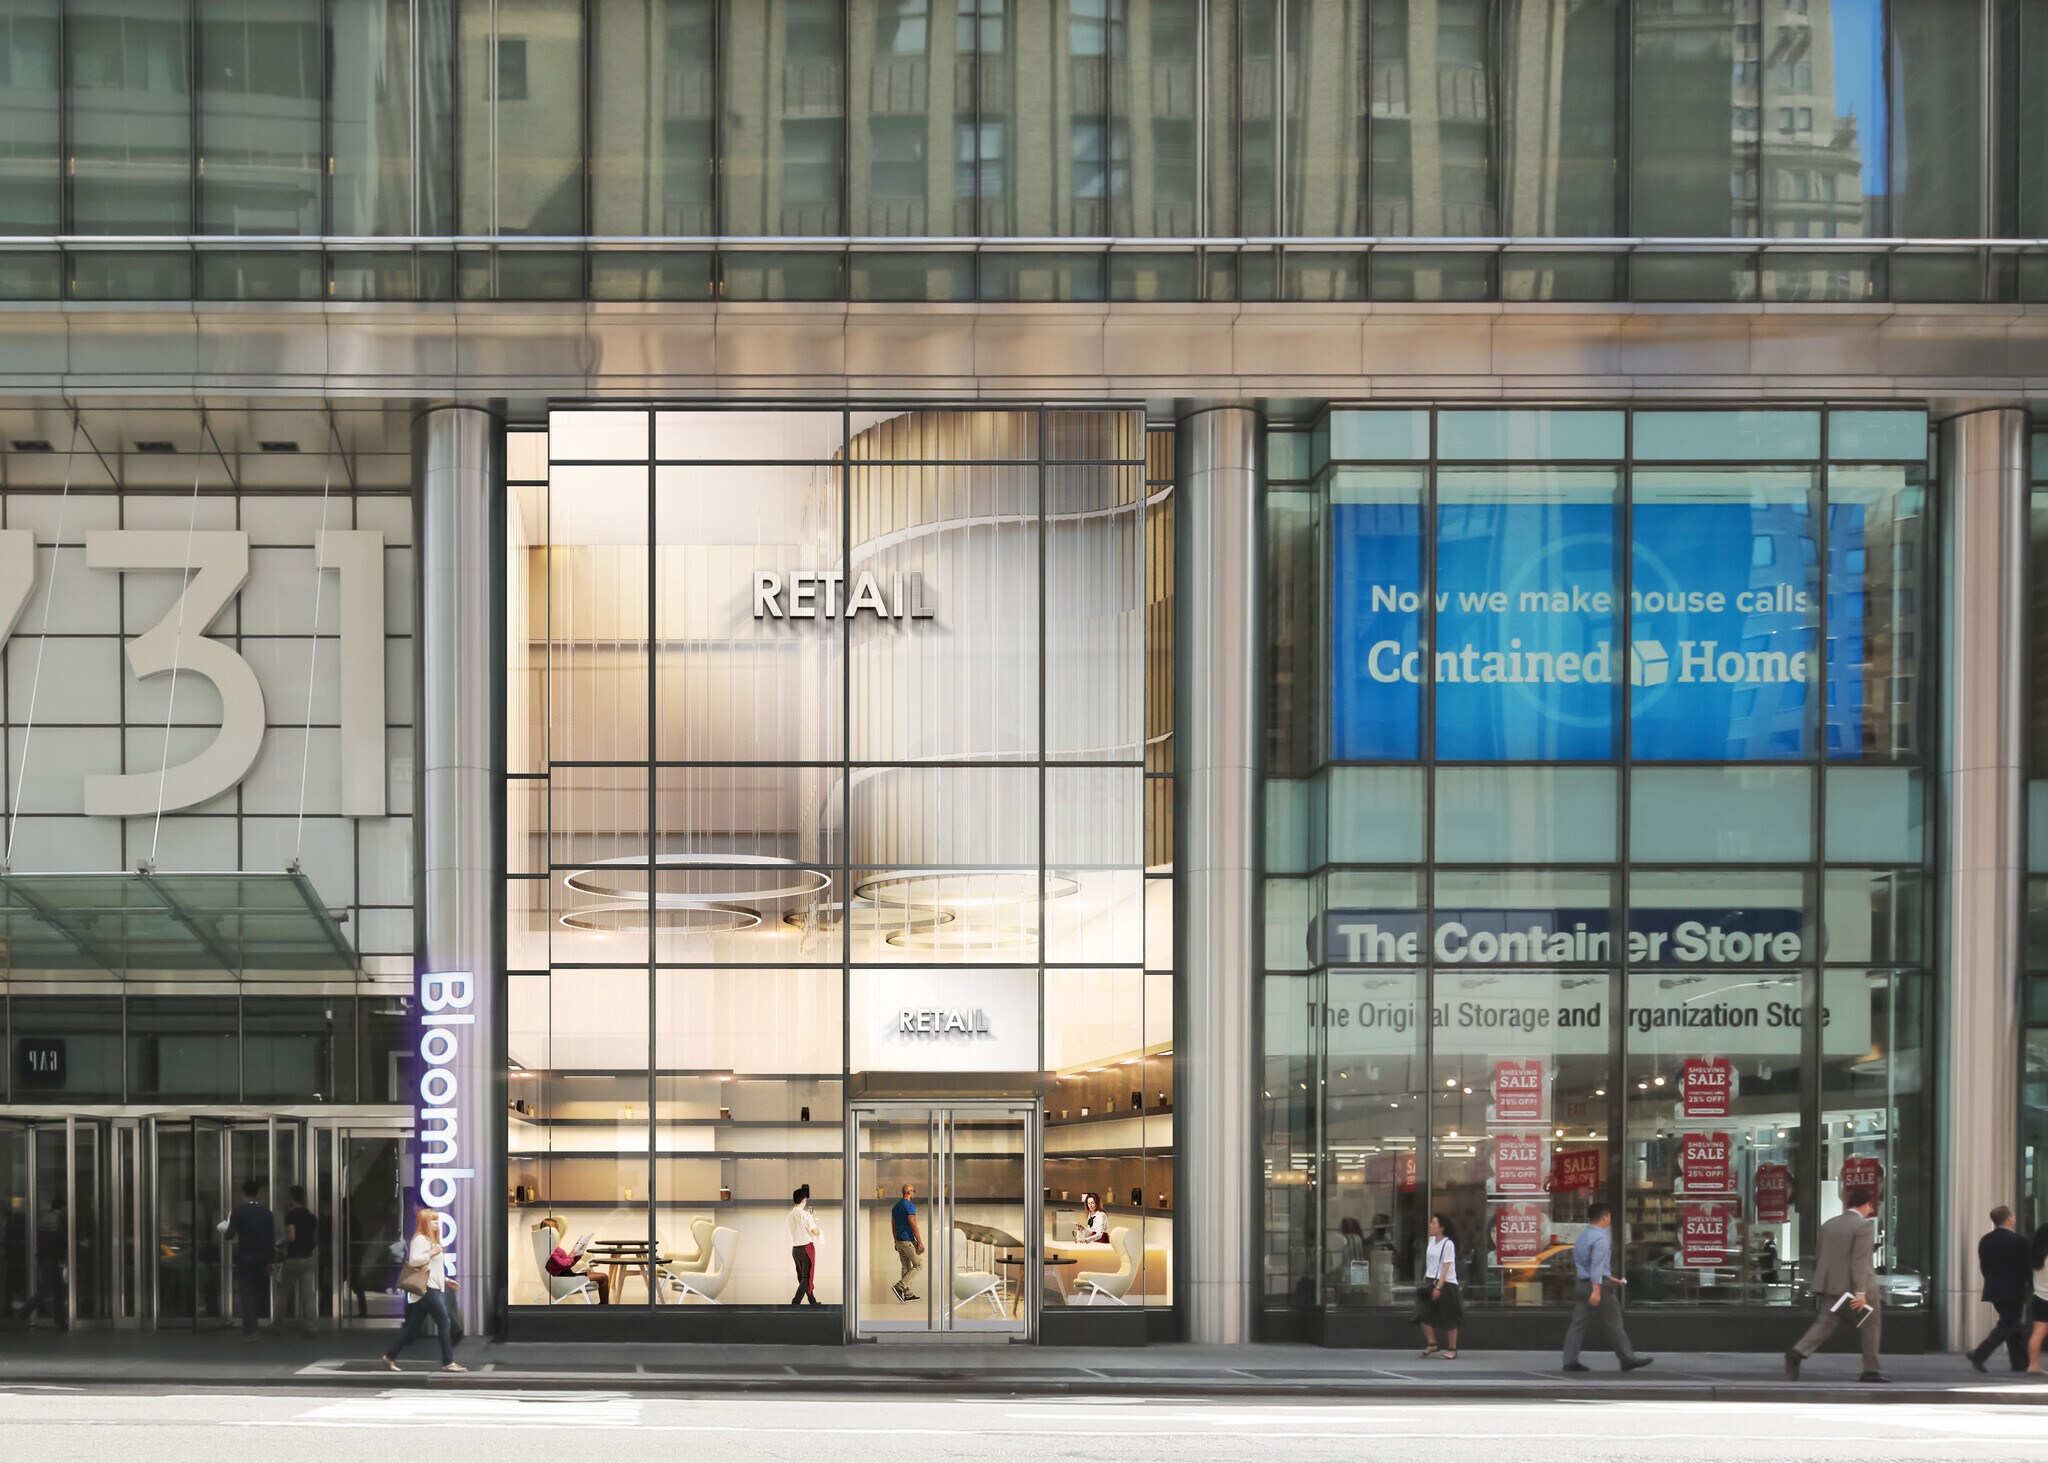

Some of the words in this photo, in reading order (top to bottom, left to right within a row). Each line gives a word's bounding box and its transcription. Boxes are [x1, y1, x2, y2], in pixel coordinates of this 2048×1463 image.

[753, 571, 935, 619] RETAIL
[1458, 592, 1509, 613] we
[1519, 584, 1613, 613] make
[1368, 638, 1613, 683] Contained
[1677, 640, 1806, 683] Home
[0, 529, 386, 818] 31
[1337, 923, 1418, 963] The
[1433, 921, 1668, 963] Container
[1674, 921, 1801, 963] Store
[899, 1008, 988, 1033] RETAIL
[1358, 1001, 1449, 1033] Origial
[1458, 1002, 1550, 1033] Storage
[1558, 1002, 1601, 1027] and
[1628, 1002, 1758, 1033] rganization
[1766, 1001, 1831, 1028] Stoe
[1500, 1076, 1538, 1088] SALE
[1688, 1073, 1725, 1086] SALE
[1500, 1149, 1537, 1160] SALE
[1687, 1148, 1724, 1160] SALE
[1564, 1156, 1596, 1173] SALE
[1687, 1170, 1704, 1178] 25%
[1845, 1173, 1875, 1186] SALE
[1759, 1178, 1785, 1190] SALE
[1500, 1221, 1537, 1233] SALE
[1686, 1222, 1723, 1234] SALE
